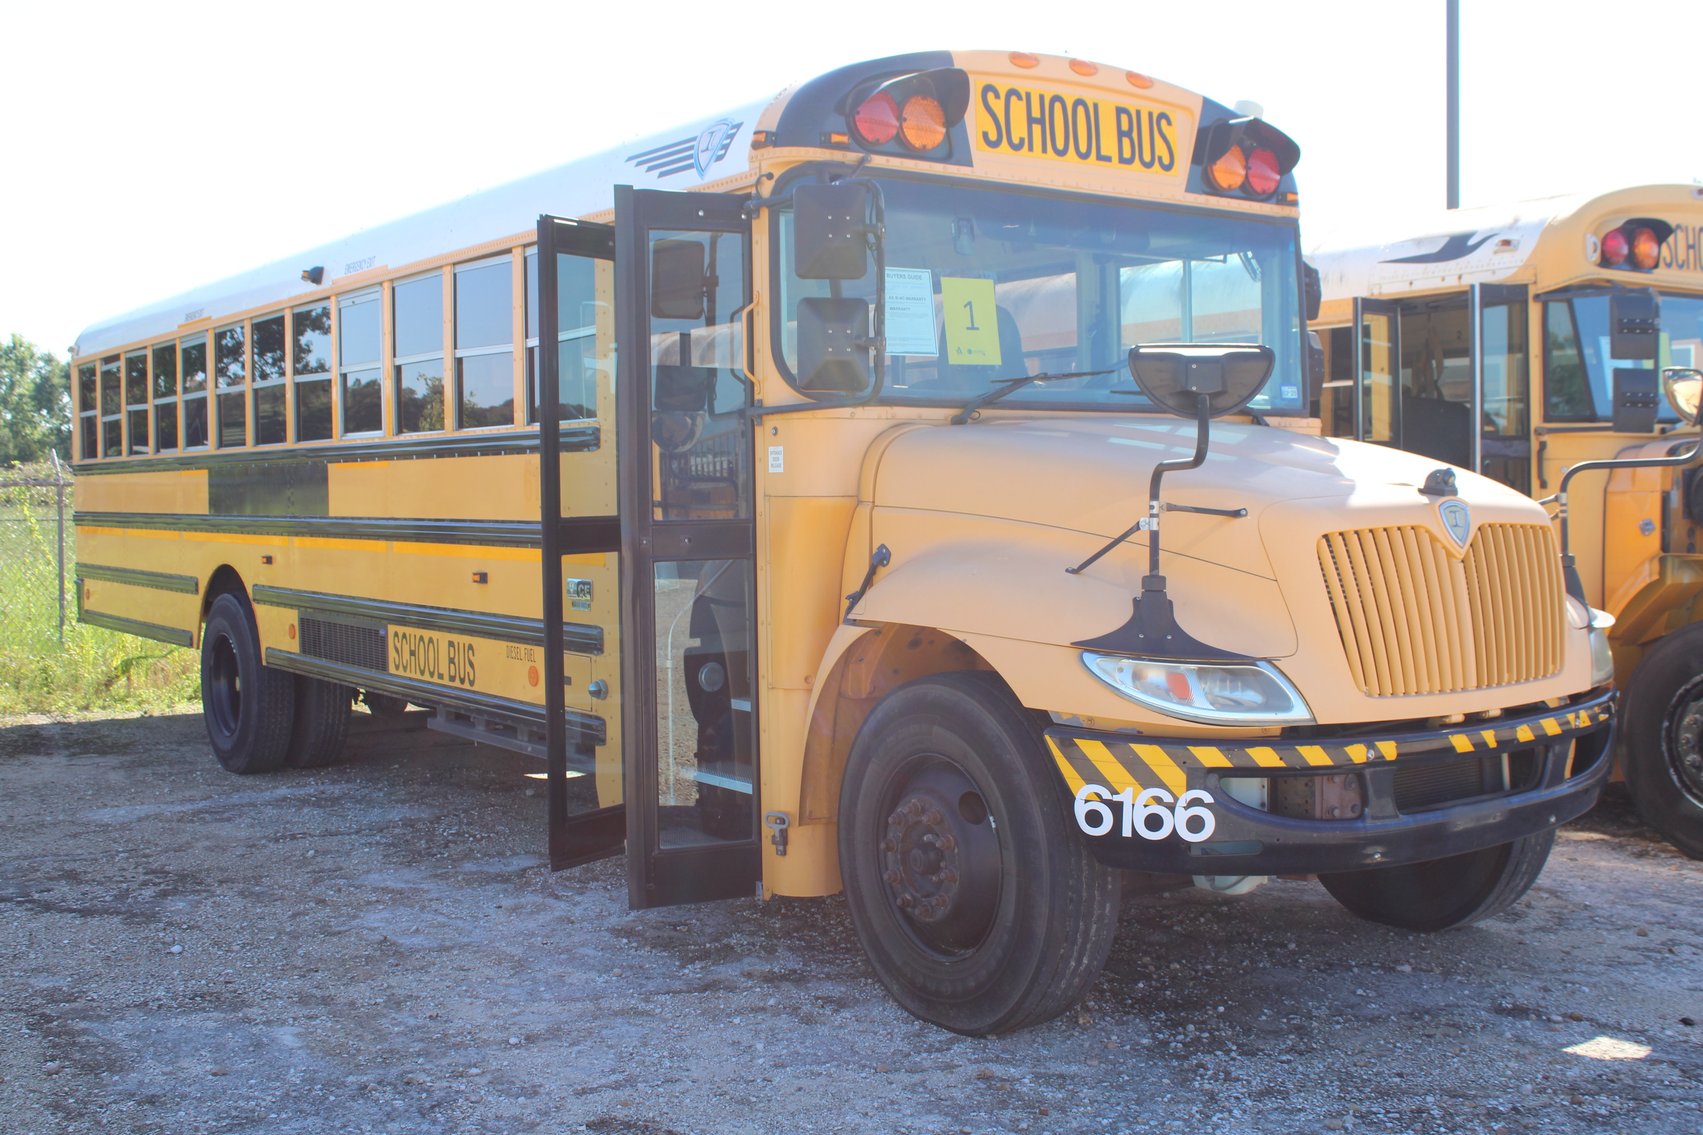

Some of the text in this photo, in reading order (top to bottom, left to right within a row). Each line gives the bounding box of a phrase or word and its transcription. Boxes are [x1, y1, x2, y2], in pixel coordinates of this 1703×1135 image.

[981, 84, 1175, 173] SCHOOL BUS
[963, 300, 979, 331] 1
[393, 630, 476, 688] SCHOOL BUS
[506, 645, 537, 663] DIESEL FUEL
[1074, 783, 1216, 843] 6166
